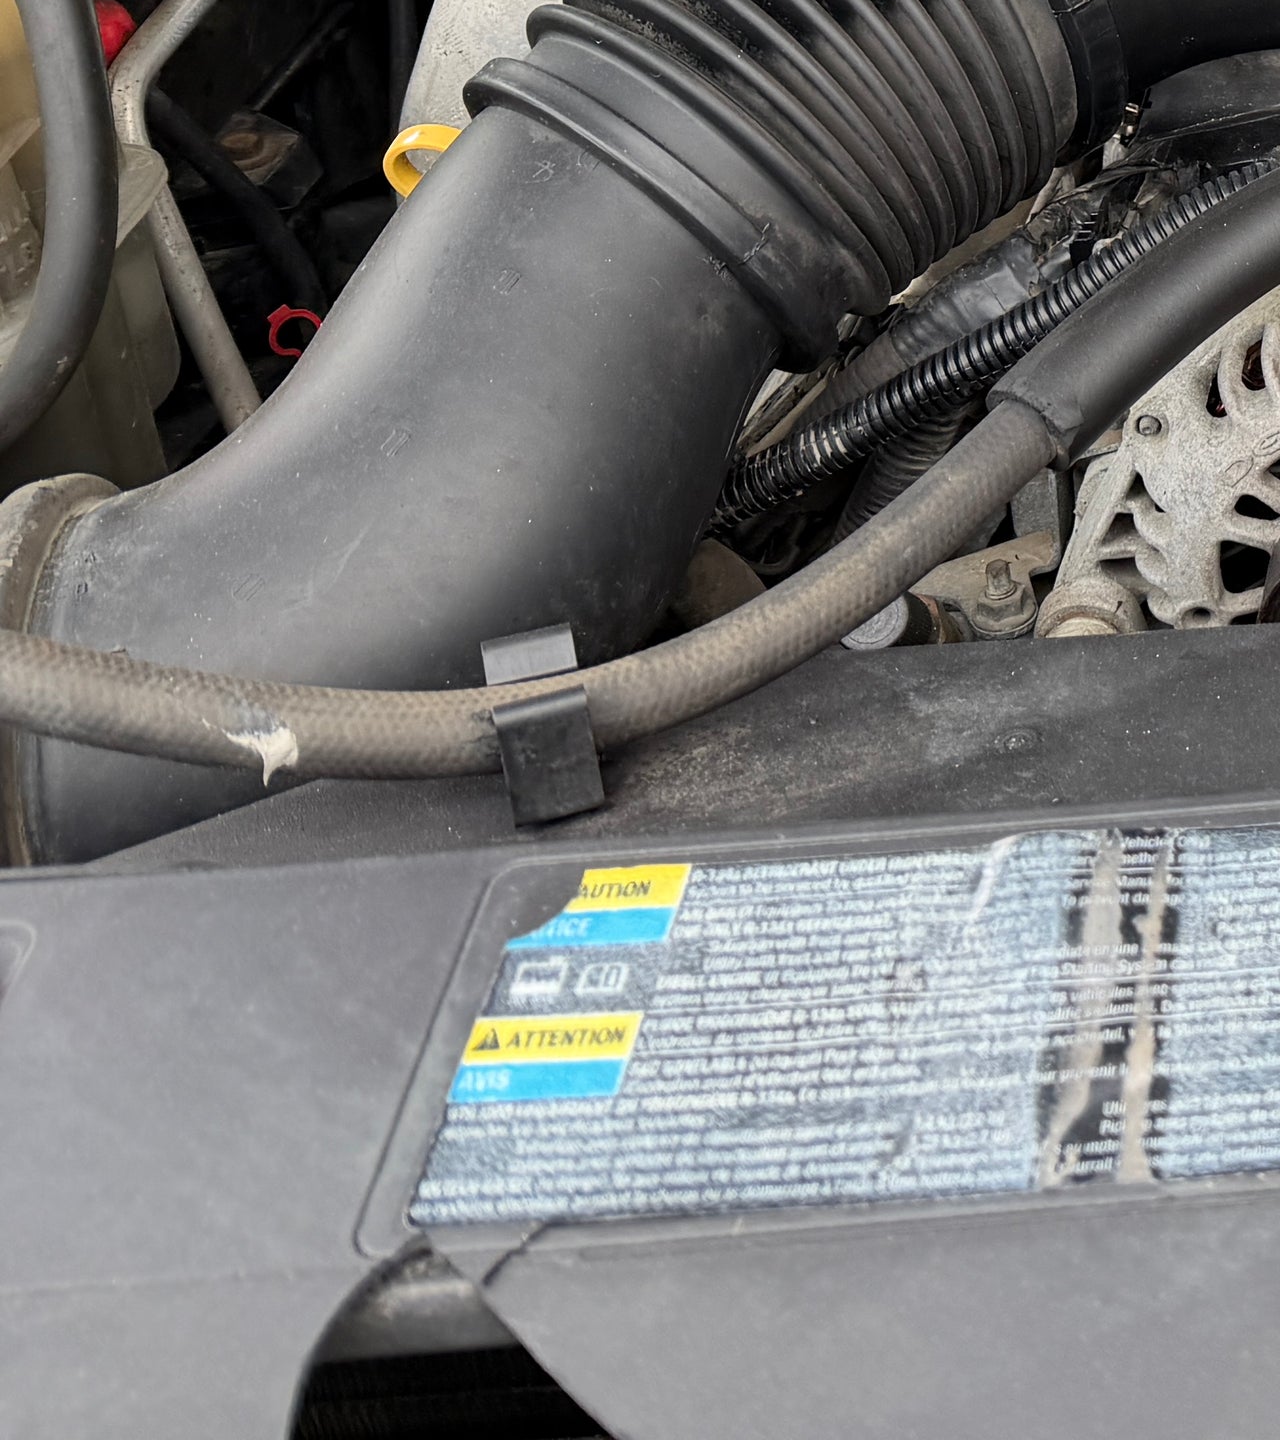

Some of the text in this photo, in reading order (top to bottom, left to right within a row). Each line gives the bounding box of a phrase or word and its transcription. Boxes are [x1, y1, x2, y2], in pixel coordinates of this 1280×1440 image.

[1120, 835, 1174, 850] Vehicle
[505, 1026, 628, 1049] ATTENTION
[456, 1068, 513, 1092] AVIS
